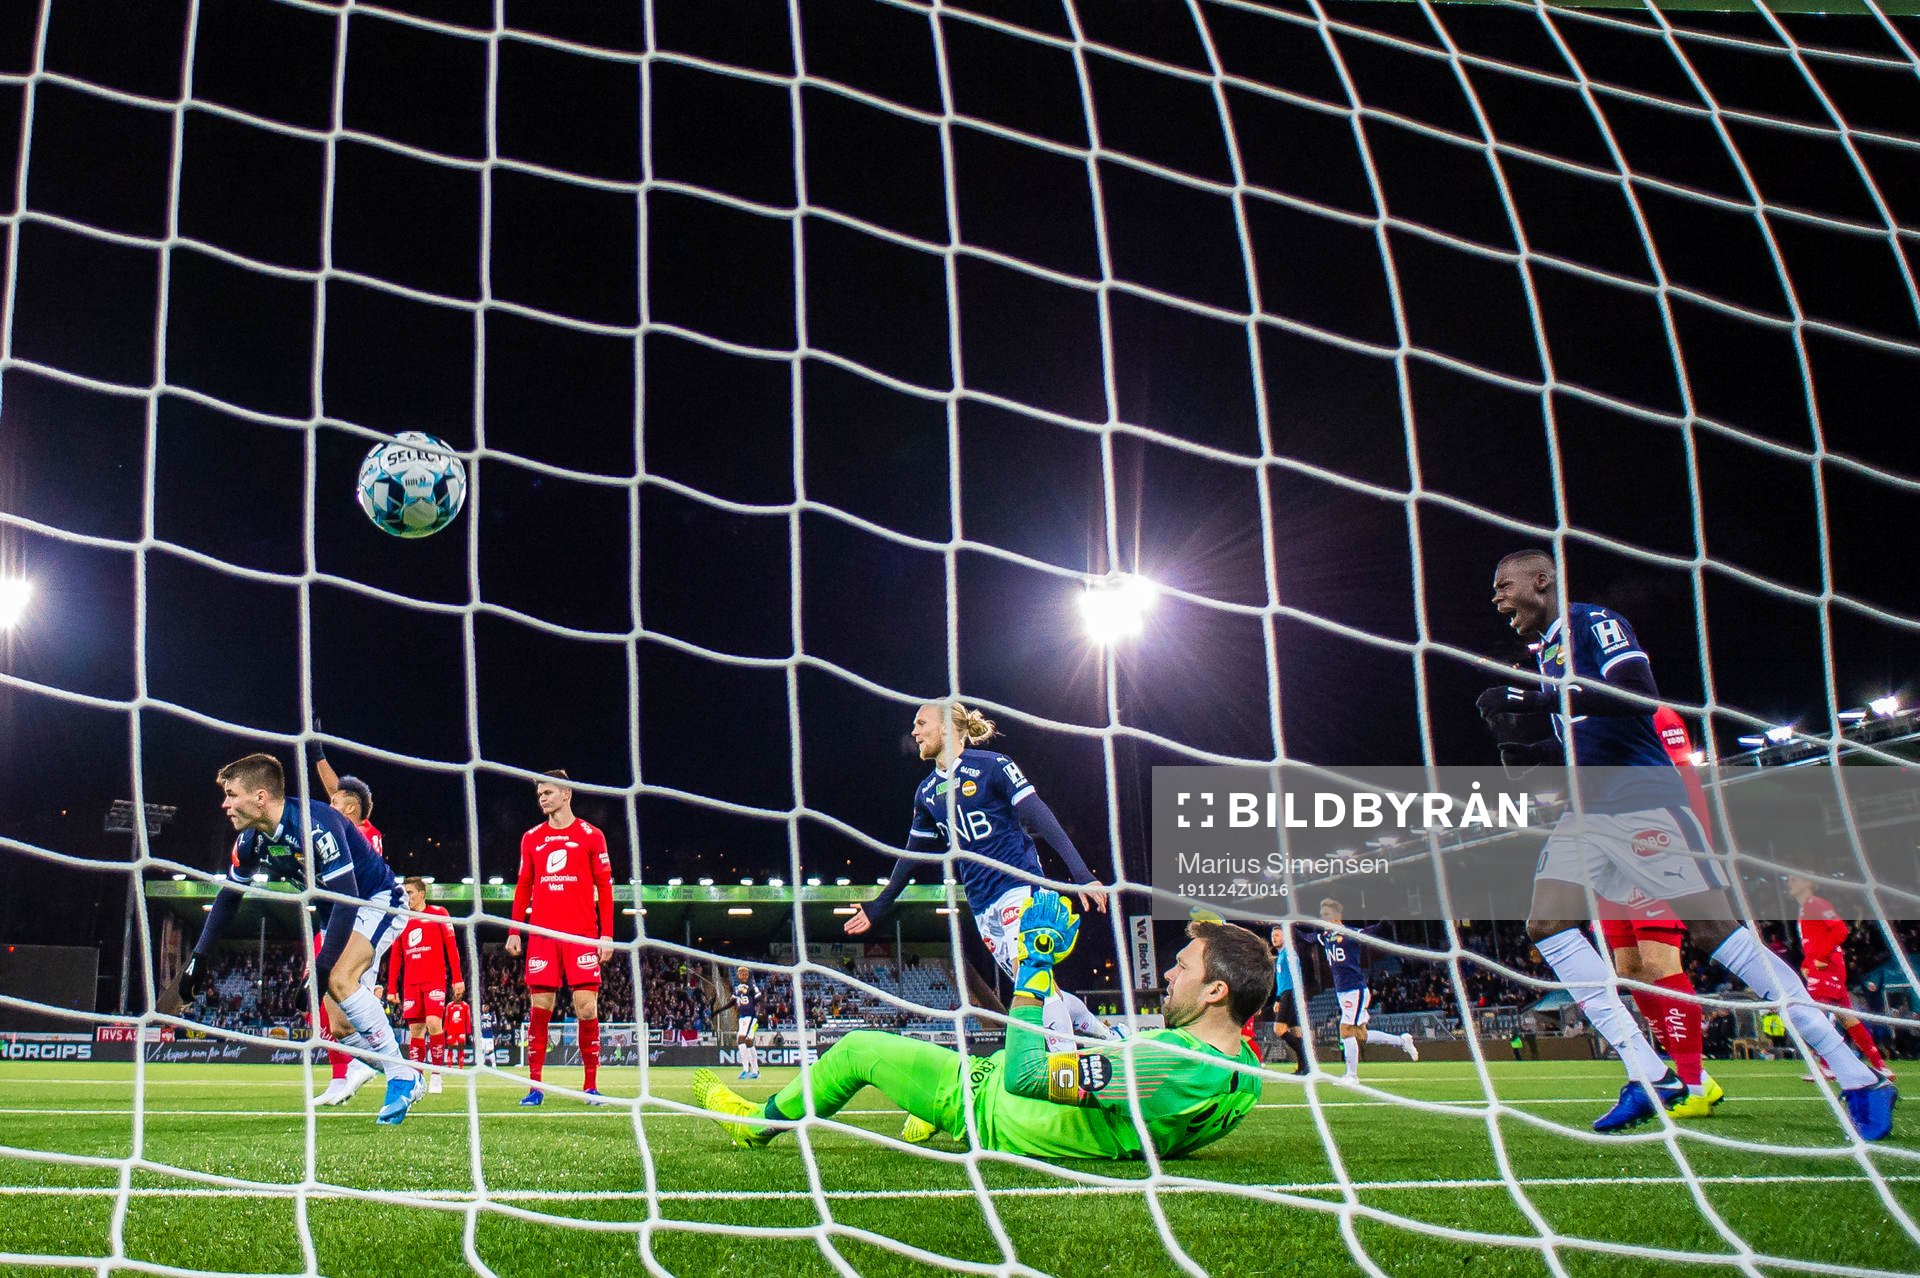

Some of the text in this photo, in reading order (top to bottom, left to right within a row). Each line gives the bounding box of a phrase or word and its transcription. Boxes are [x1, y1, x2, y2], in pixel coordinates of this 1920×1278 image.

[102, 1029, 122, 1041] RVS
[719, 1049, 818, 1065] NRGIPS
[1089, 1055, 1104, 1088] REMA
